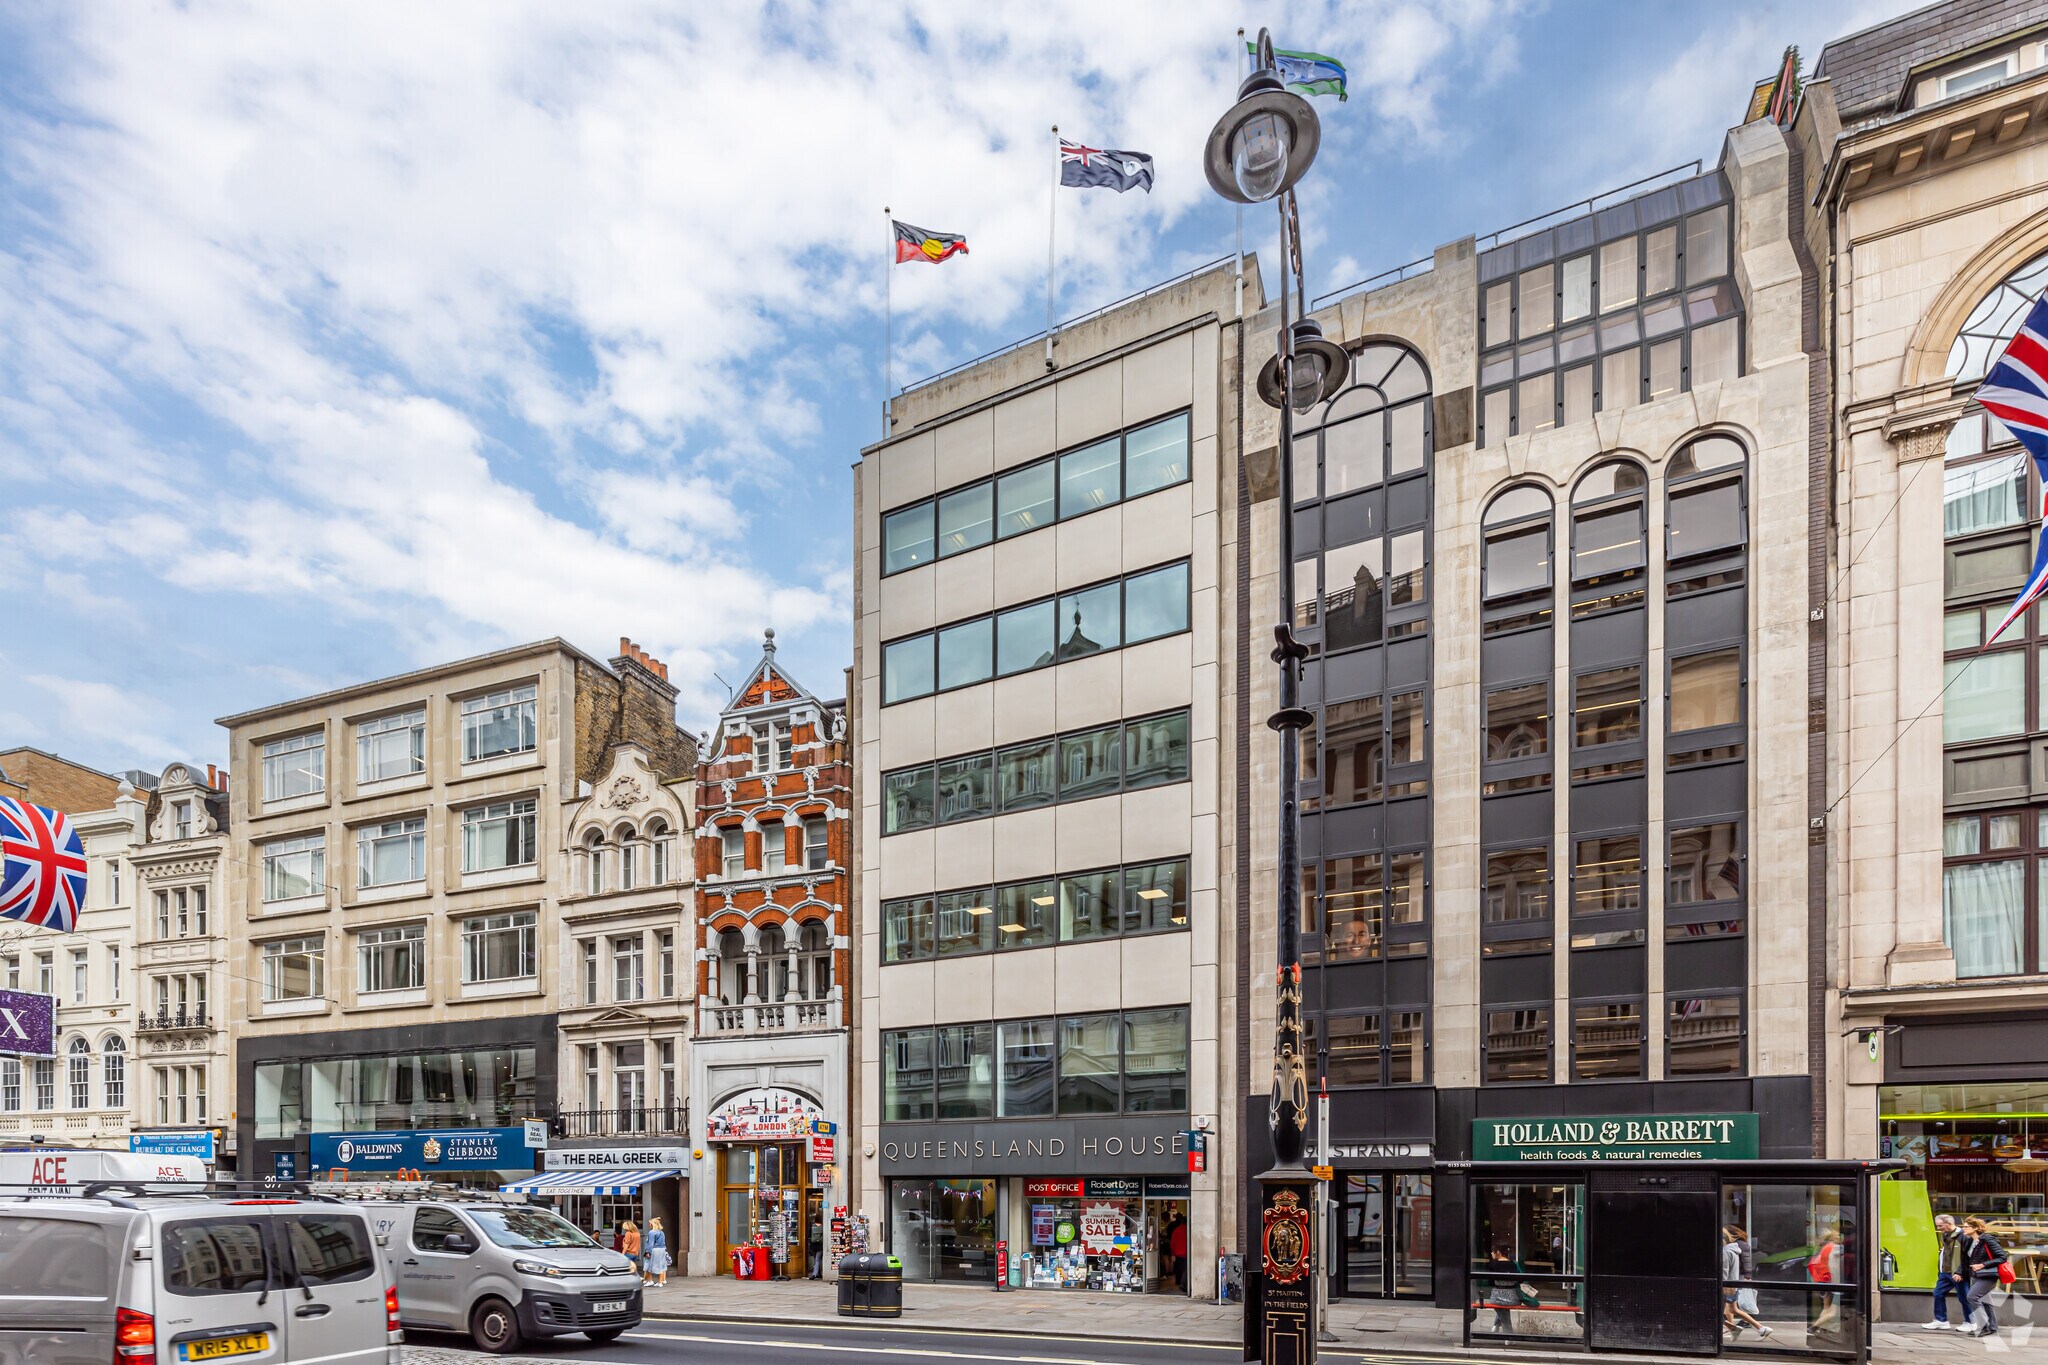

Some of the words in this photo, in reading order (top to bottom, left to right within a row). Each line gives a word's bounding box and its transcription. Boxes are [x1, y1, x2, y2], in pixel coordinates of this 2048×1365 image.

[759, 1115, 779, 1123] GIFT
[753, 1122, 787, 1131] LONDON
[1493, 1123, 1594, 1146] HOLLAND
[1599, 1121, 1620, 1145] &
[1625, 1120, 1735, 1144] BARRETT
[450, 1138, 494, 1146] STANLEY
[176, 1145, 206, 1153] CHANGE
[356, 1144, 402, 1154] BALDWIN'S
[448, 1146, 498, 1157] GIBBONS
[884, 1138, 1065, 1161] QUEENSLAND
[1083, 1136, 1183, 1156] HOUSE
[1333, 1144, 1411, 1157] STRAND
[562, 1153, 585, 1165] THE
[588, 1153, 619, 1165] REAL
[622, 1152, 662, 1165] GREEK
[1520, 1150, 1553, 1160] health
[1556, 1150, 1587, 1160] foods
[1591, 1150, 1600, 1159] &
[1605, 1149, 1645, 1159] natural
[1649, 1149, 1702, 1159] remedies
[32, 1156, 67, 1184] ACE
[158, 1166, 184, 1177] ACE
[1029, 1184, 1049, 1192] POST
[1050, 1183, 1079, 1192] OFFICE
[1090, 1180, 1118, 1189] Robert
[1119, 1180, 1139, 1190] Dyas
[1085, 1225, 1121, 1236] SALE
[235, 1336, 263, 1351] XLT
